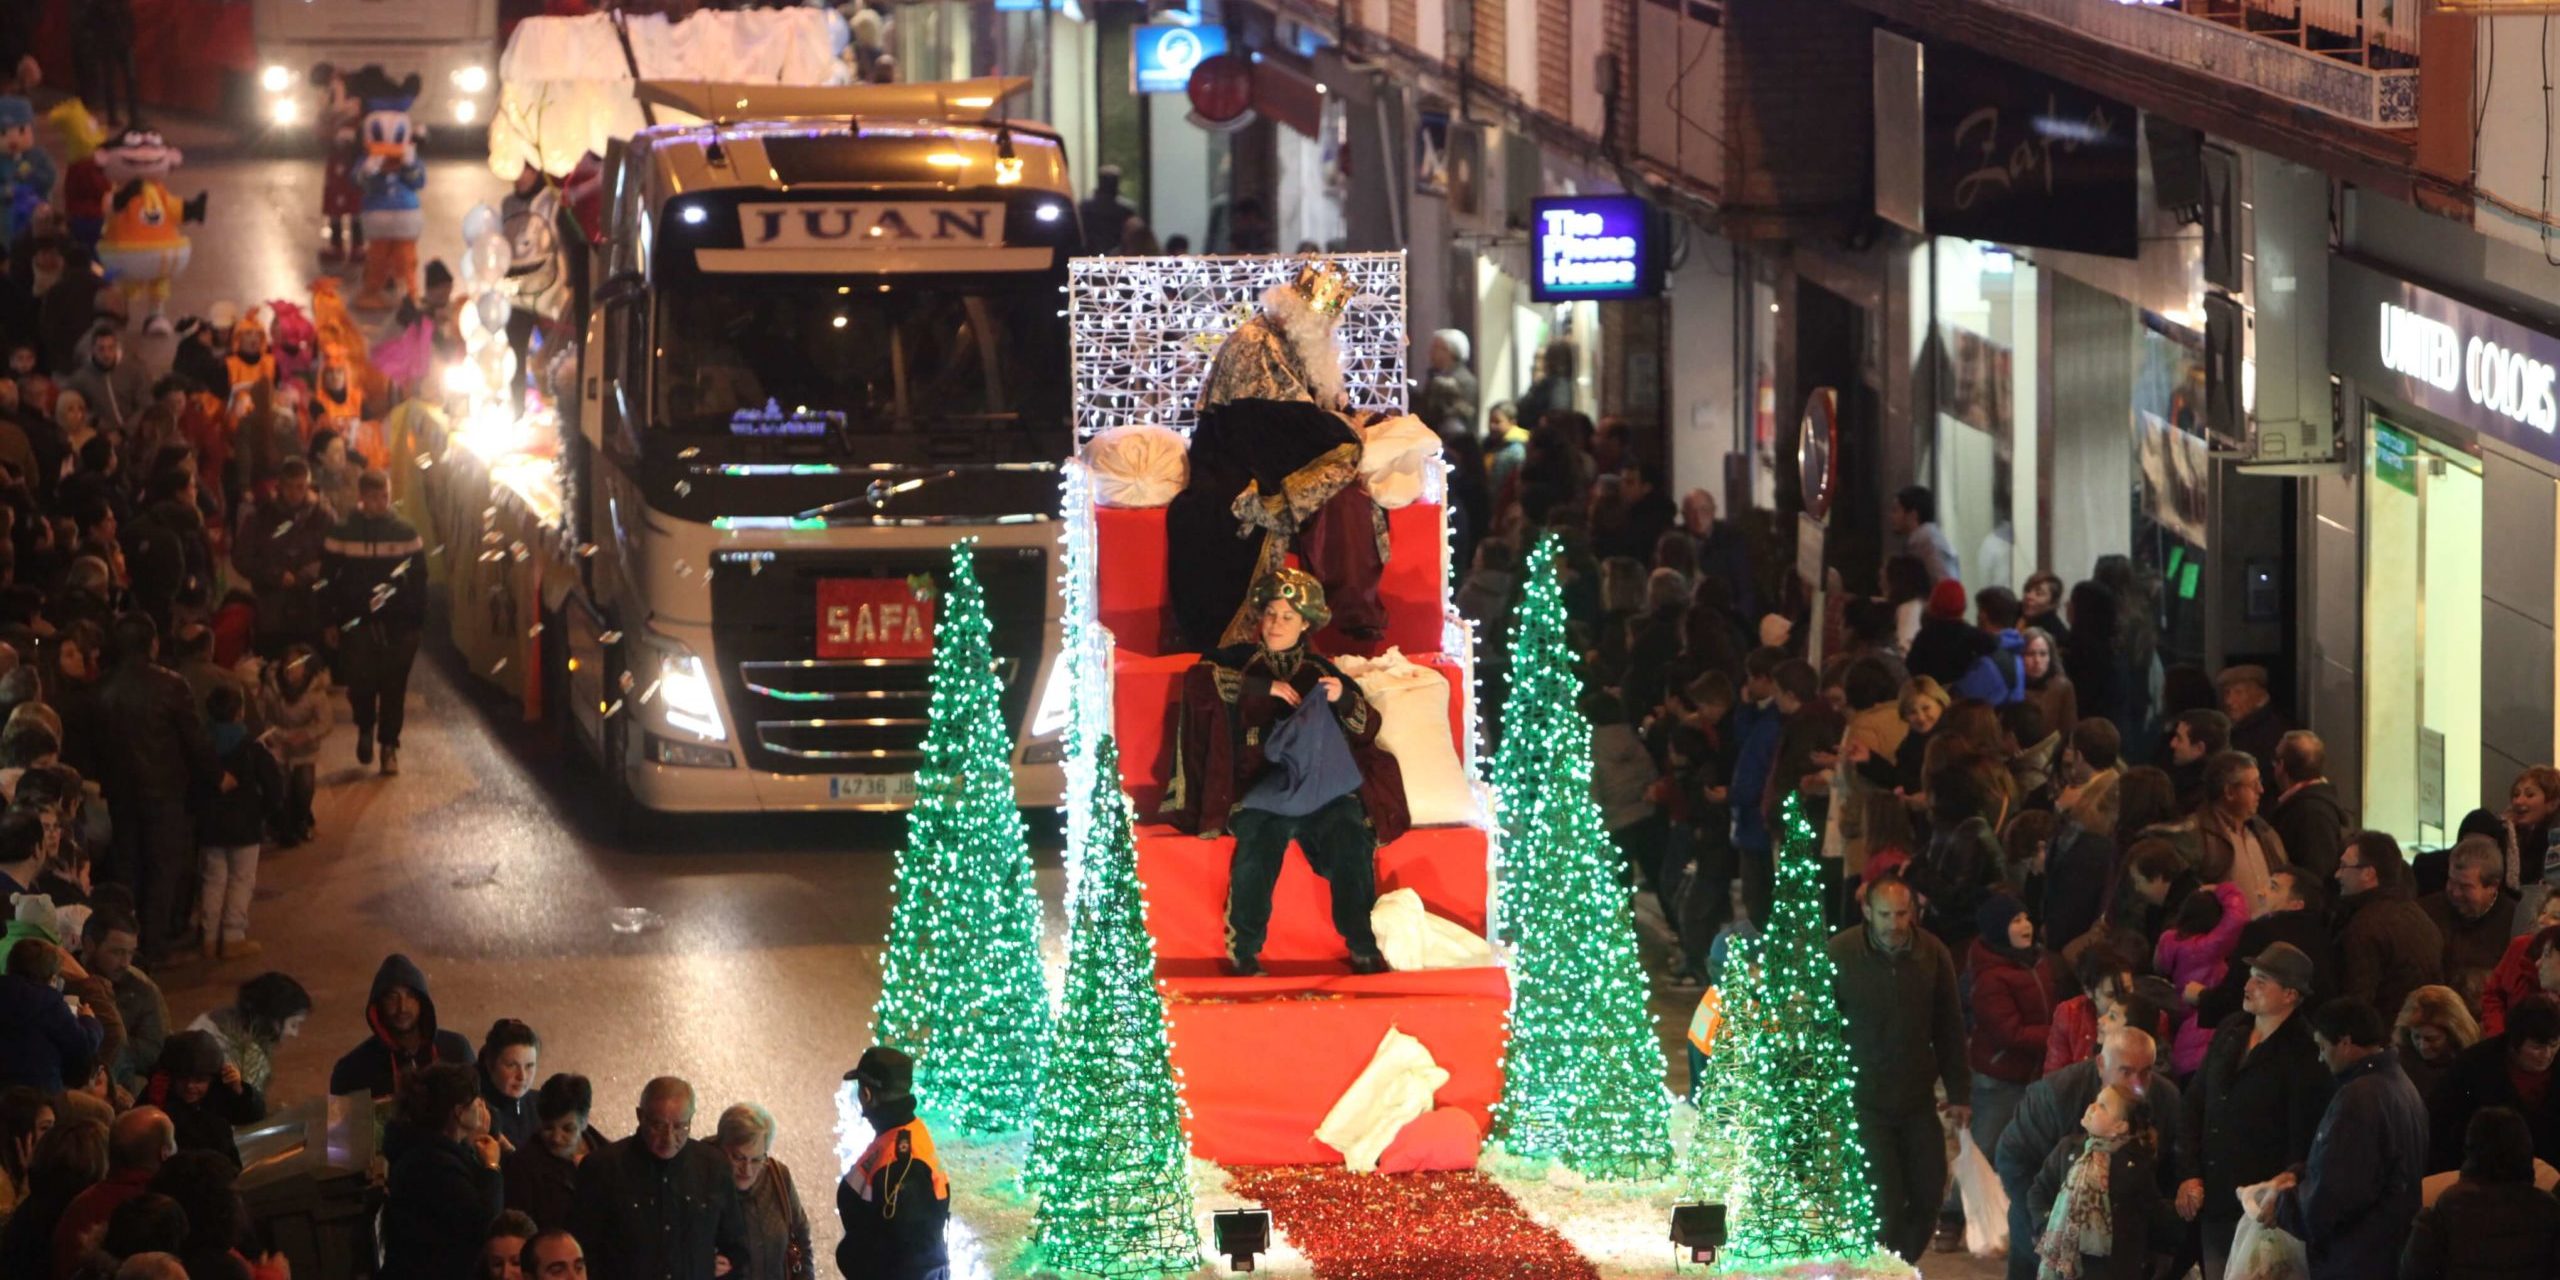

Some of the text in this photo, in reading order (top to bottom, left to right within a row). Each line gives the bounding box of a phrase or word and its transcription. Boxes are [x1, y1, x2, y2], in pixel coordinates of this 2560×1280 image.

[1954, 93, 2112, 210] Zafa
[757, 208, 990, 243] JUAN
[1542, 209, 1604, 236] The
[2380, 302, 2557, 434] UNITED COLORS
[827, 603, 923, 643] SAFA
[841, 777, 887, 795] 4736
